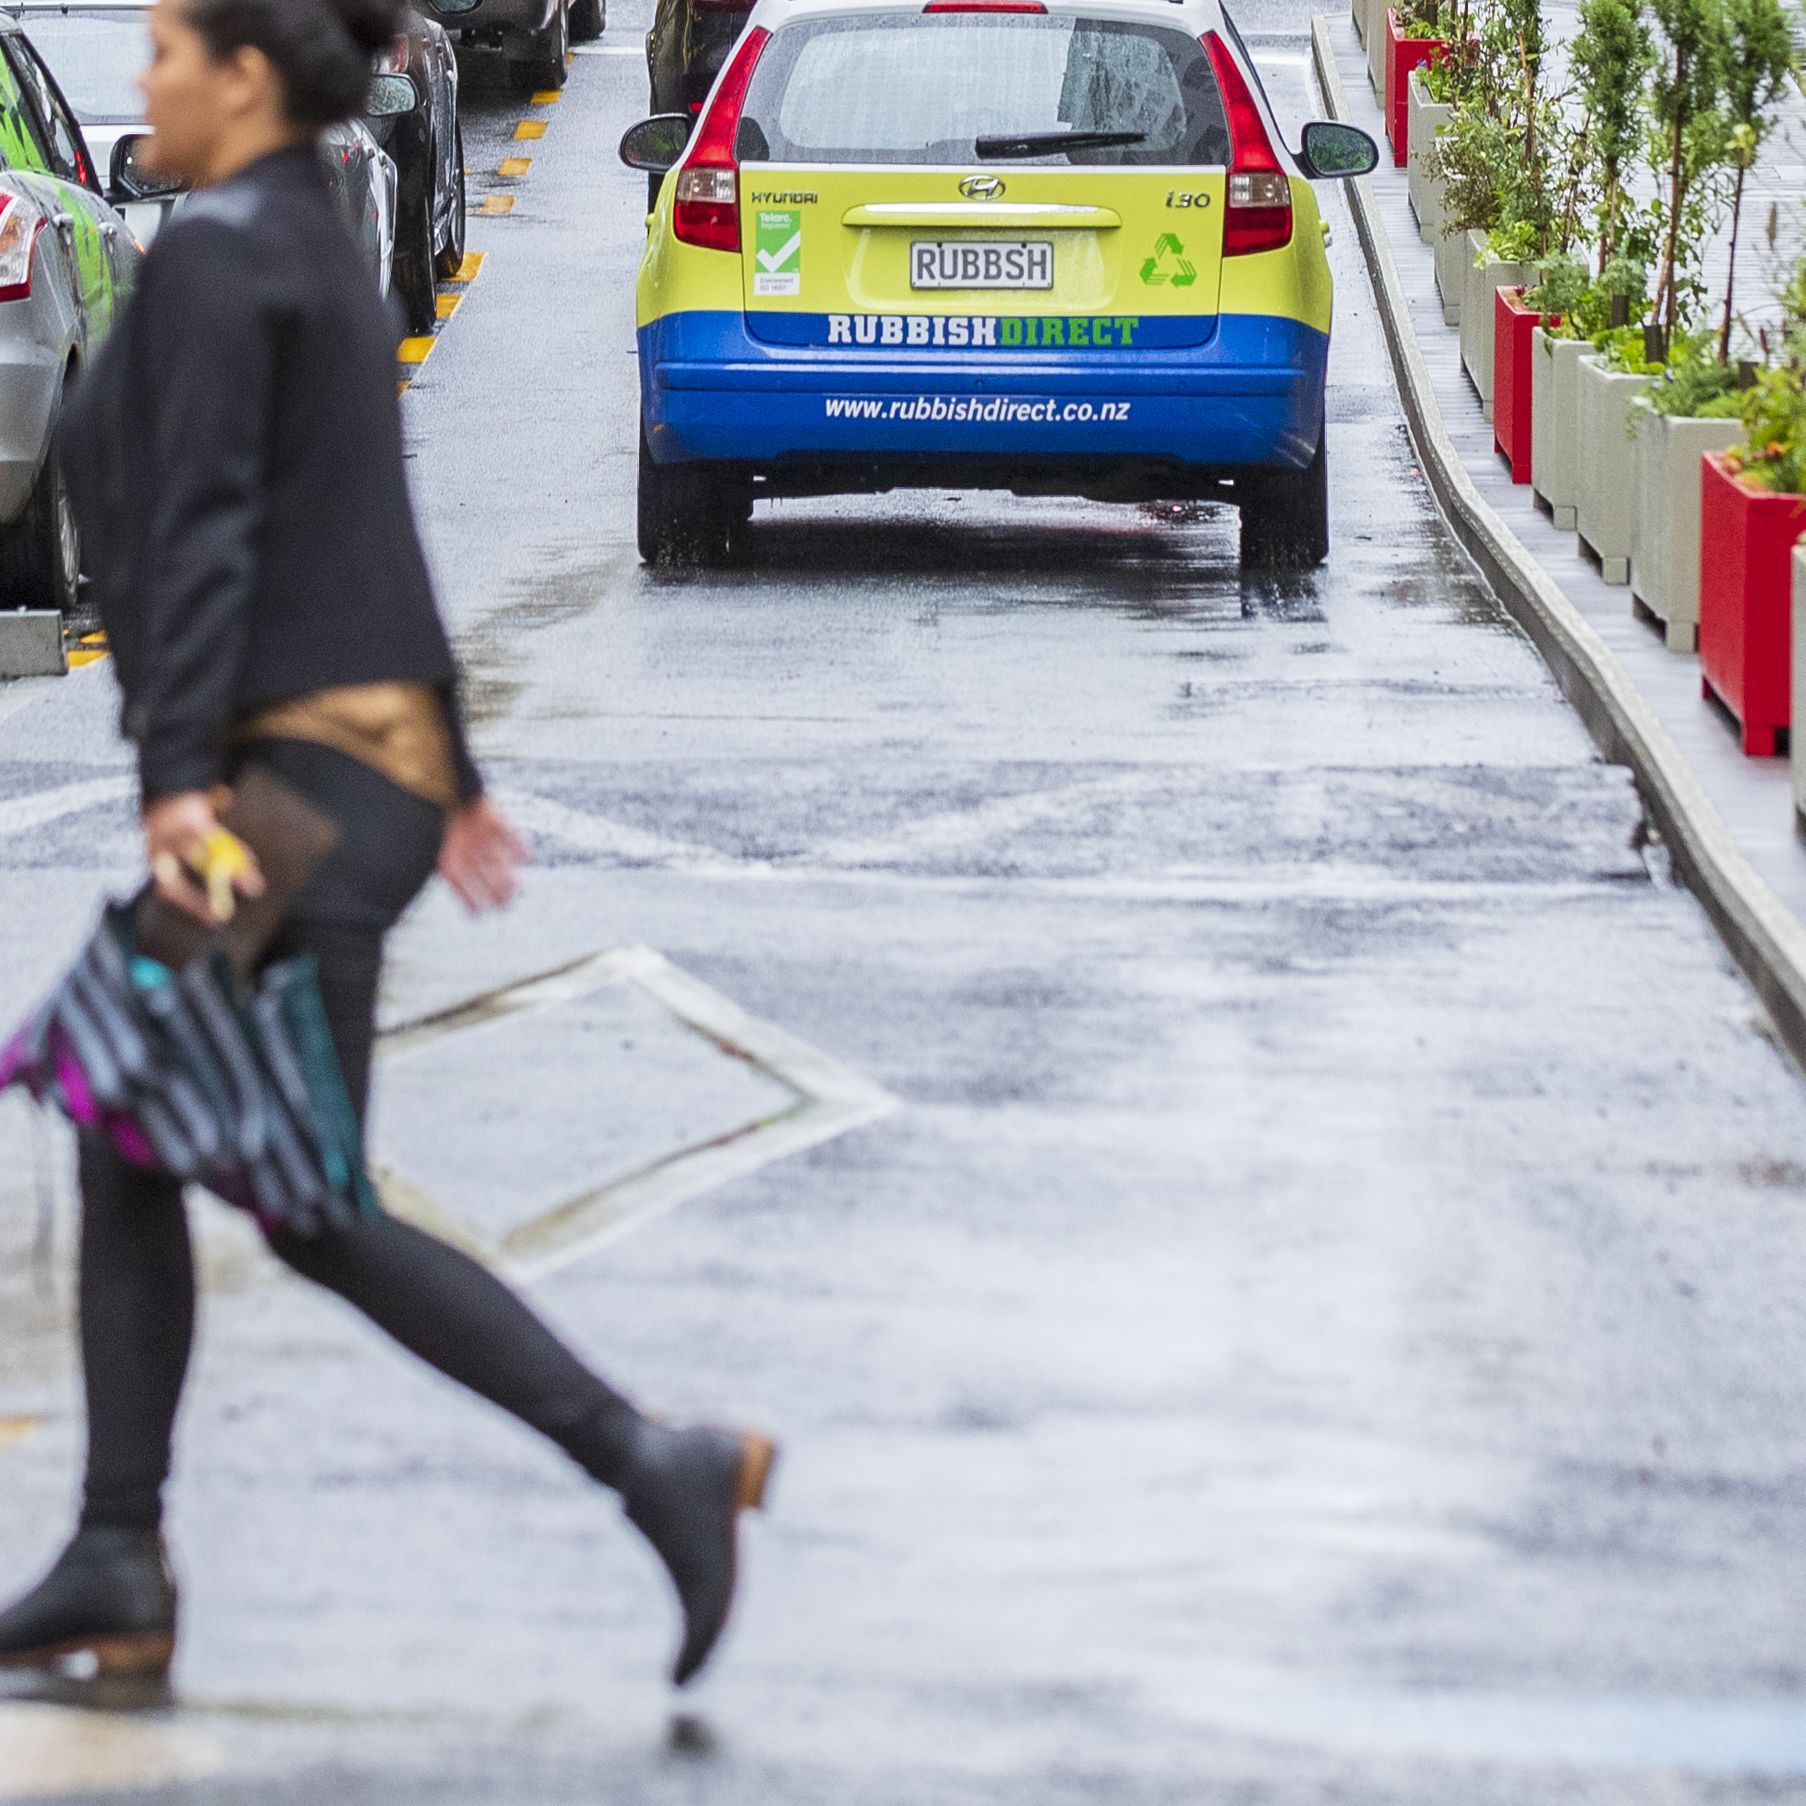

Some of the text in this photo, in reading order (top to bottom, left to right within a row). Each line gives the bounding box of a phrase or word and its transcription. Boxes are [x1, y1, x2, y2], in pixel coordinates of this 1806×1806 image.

[751, 191, 819, 205] HYUNDAI
[1164, 189, 1211, 209] i30
[916, 247, 1048, 282] RUBBSH
[825, 396, 1131, 423] www.rubbishdirect.co.nz
